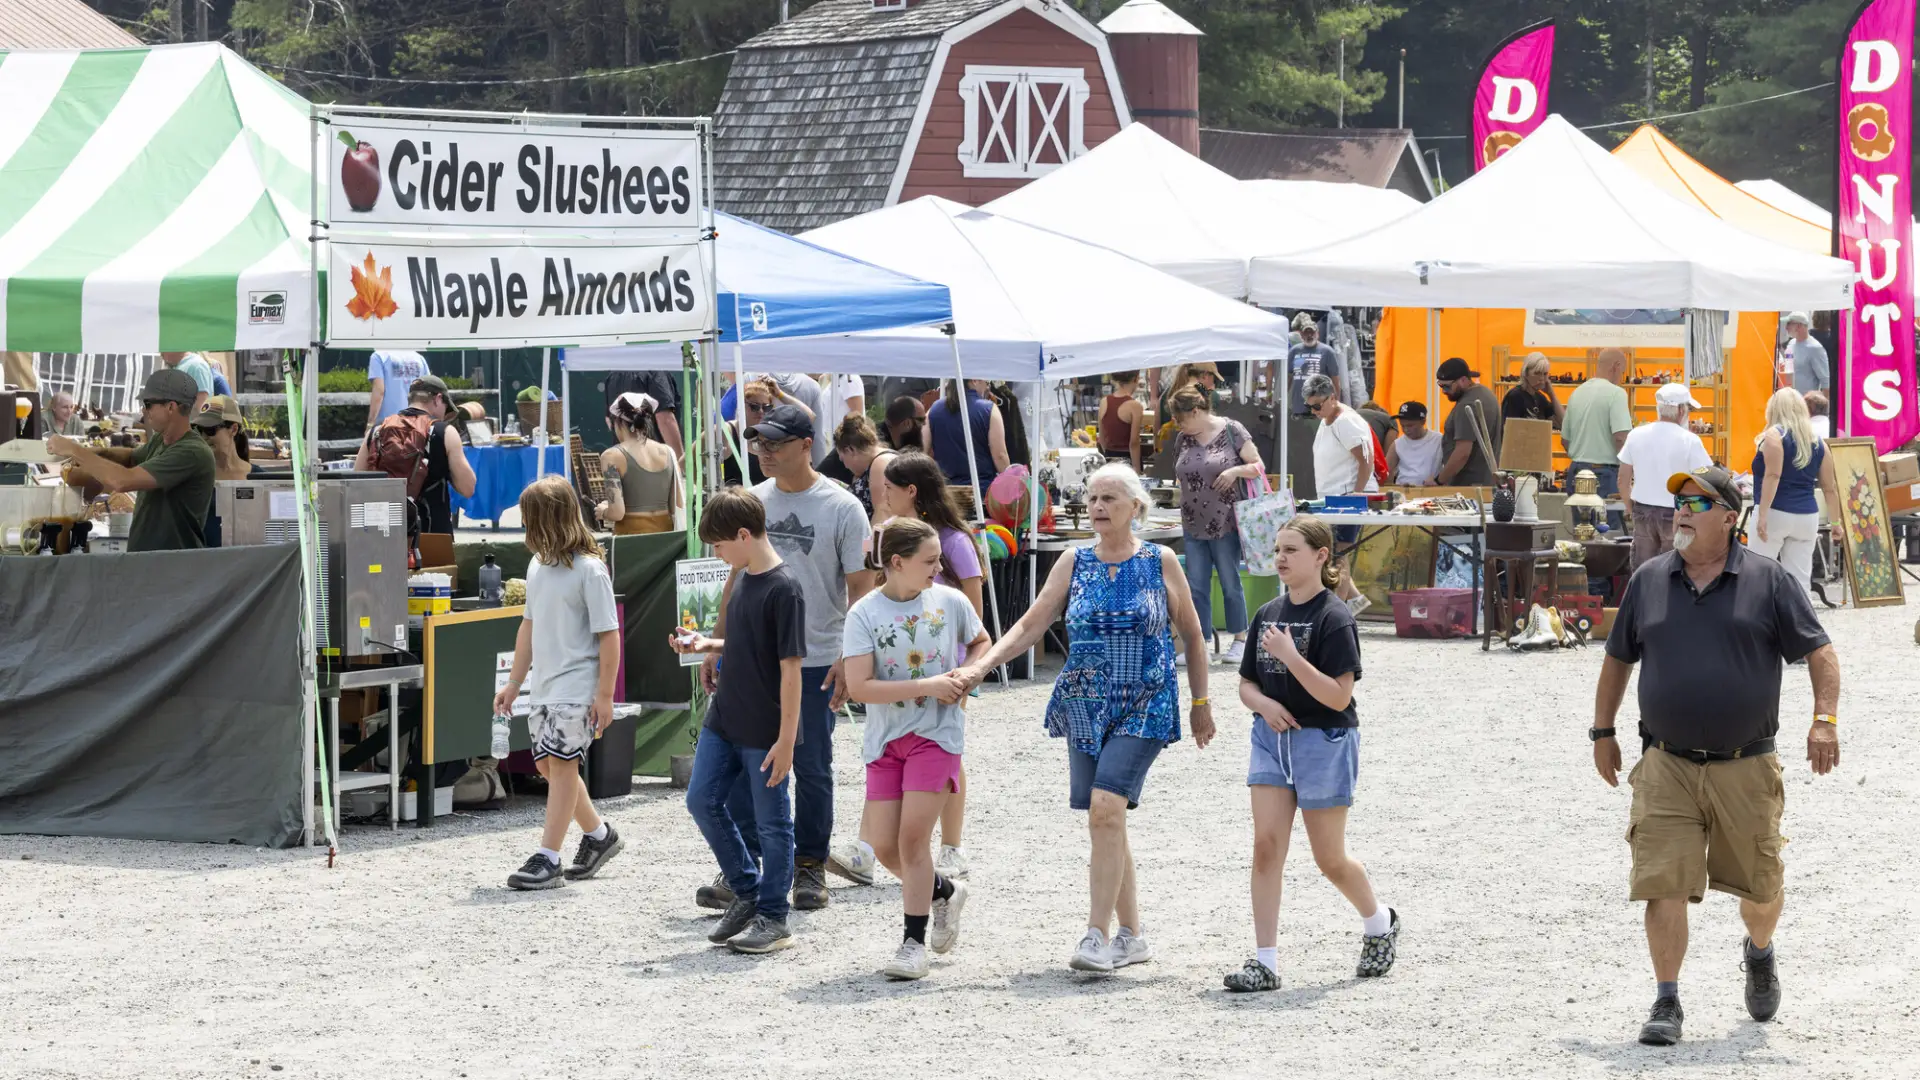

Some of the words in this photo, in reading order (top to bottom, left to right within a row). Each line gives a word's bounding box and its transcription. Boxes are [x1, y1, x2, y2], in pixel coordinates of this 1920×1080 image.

[388, 139, 504, 212] Cider
[516, 144, 690, 214] Slushees
[251, 303, 282, 318] Eurmax
[407, 257, 528, 333] Maple
[538, 255, 694, 316] Almonds
[680, 573, 696, 585] FOOD
[696, 571, 716, 584] TRUCK
